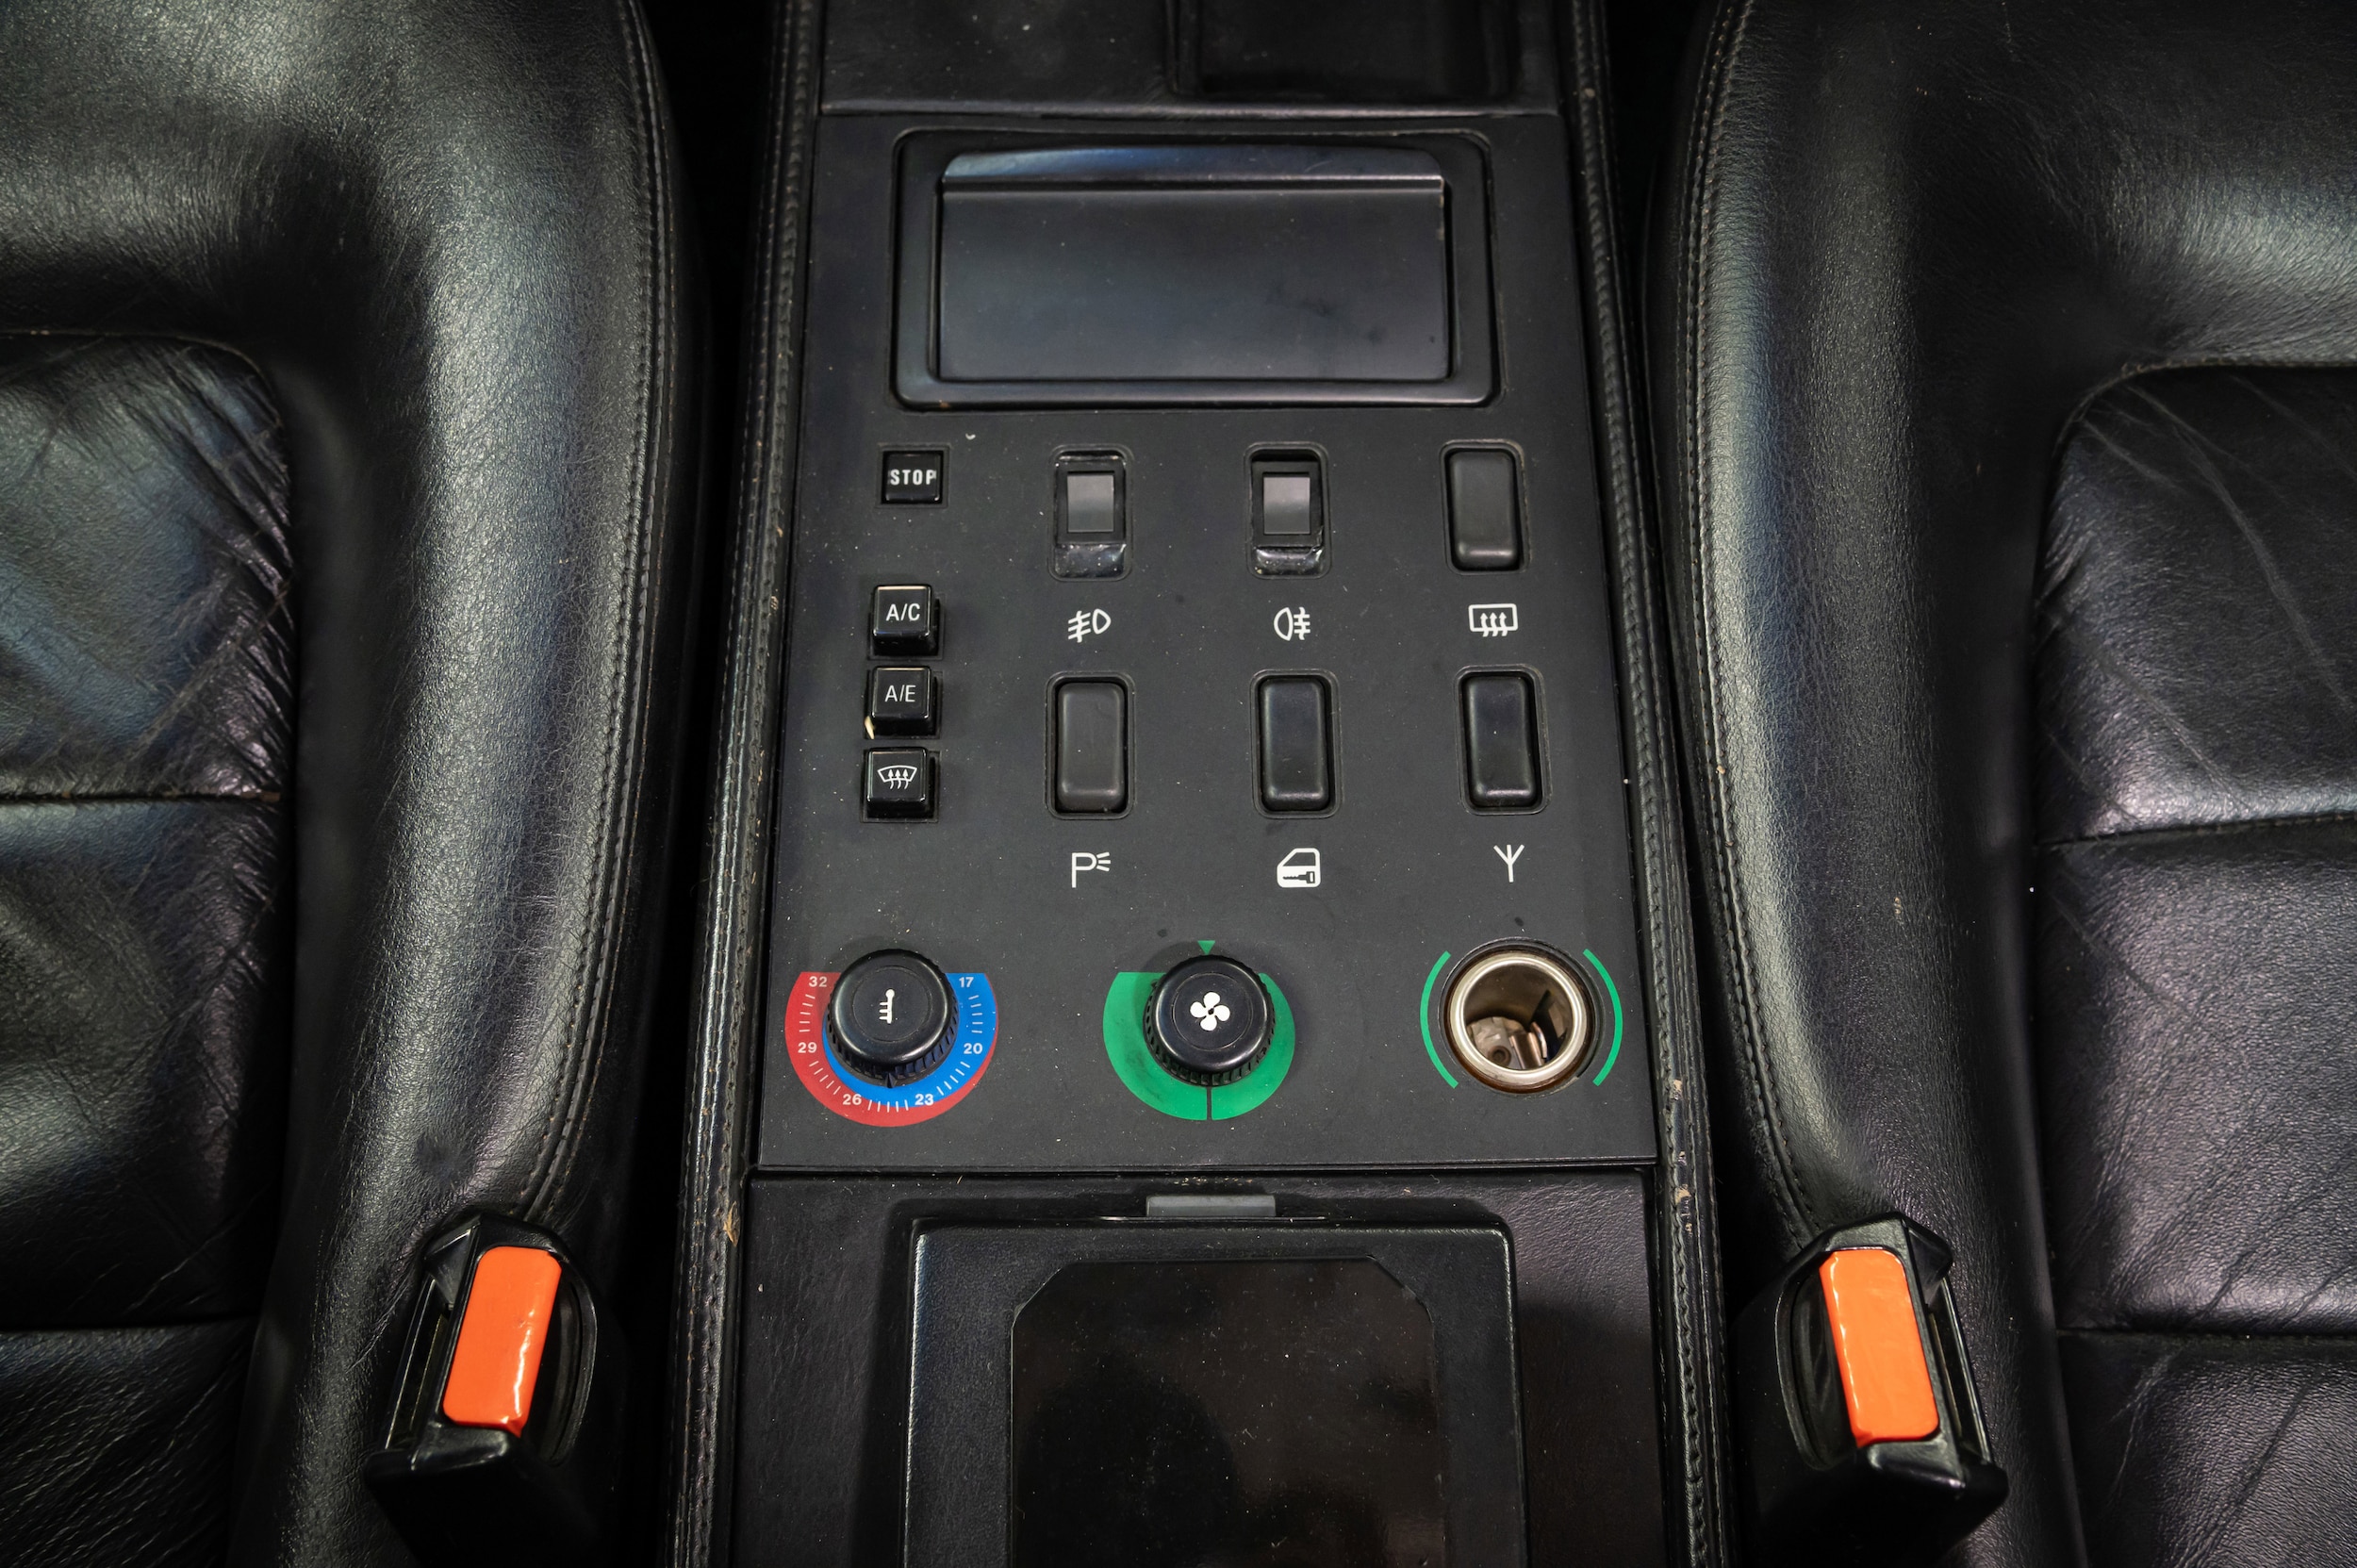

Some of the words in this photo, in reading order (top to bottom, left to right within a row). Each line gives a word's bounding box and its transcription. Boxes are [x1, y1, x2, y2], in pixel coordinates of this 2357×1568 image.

[890, 469, 937, 486] STOP
[885, 603, 921, 621] A/C
[884, 685, 916, 702] A/E
[809, 976, 827, 987] 32
[959, 977, 974, 987] 17
[798, 1042, 817, 1053] 29
[964, 1043, 982, 1054] 20
[842, 1094, 862, 1105] 26
[915, 1094, 933, 1105] 23
